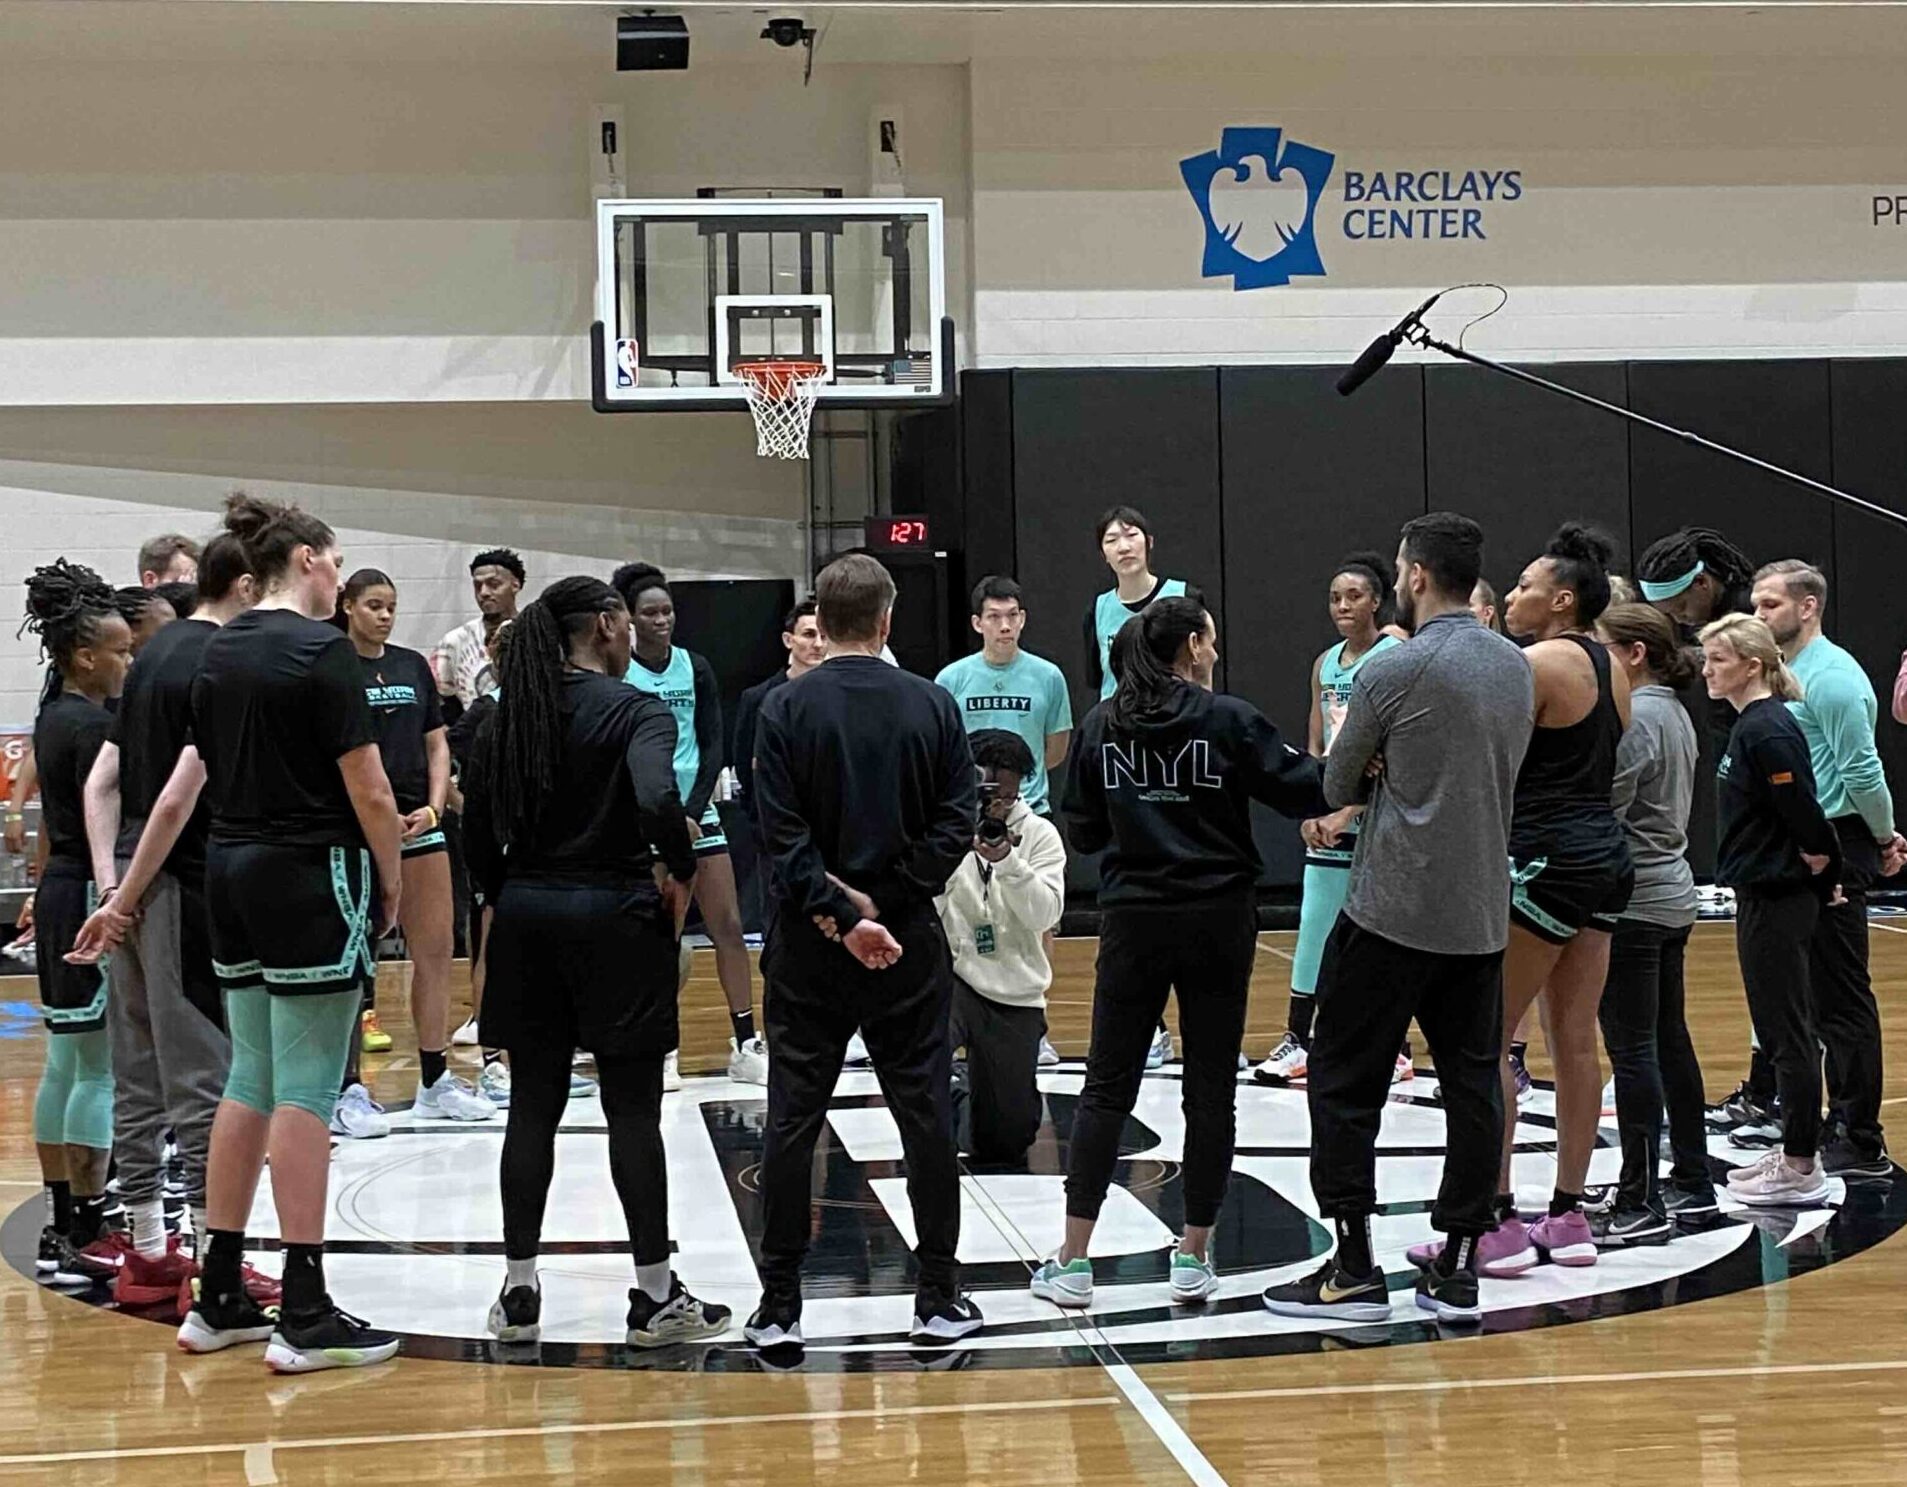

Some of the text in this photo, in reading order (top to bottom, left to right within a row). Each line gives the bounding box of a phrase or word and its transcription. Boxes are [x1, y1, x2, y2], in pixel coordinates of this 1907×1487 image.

[1343, 170, 1522, 202] BARCLAYS
[1343, 208, 1487, 240] CENTER
[968, 697, 1029, 710] LIBERTY
[4, 740, 24, 760] G
[1102, 739, 1222, 789] NYL
